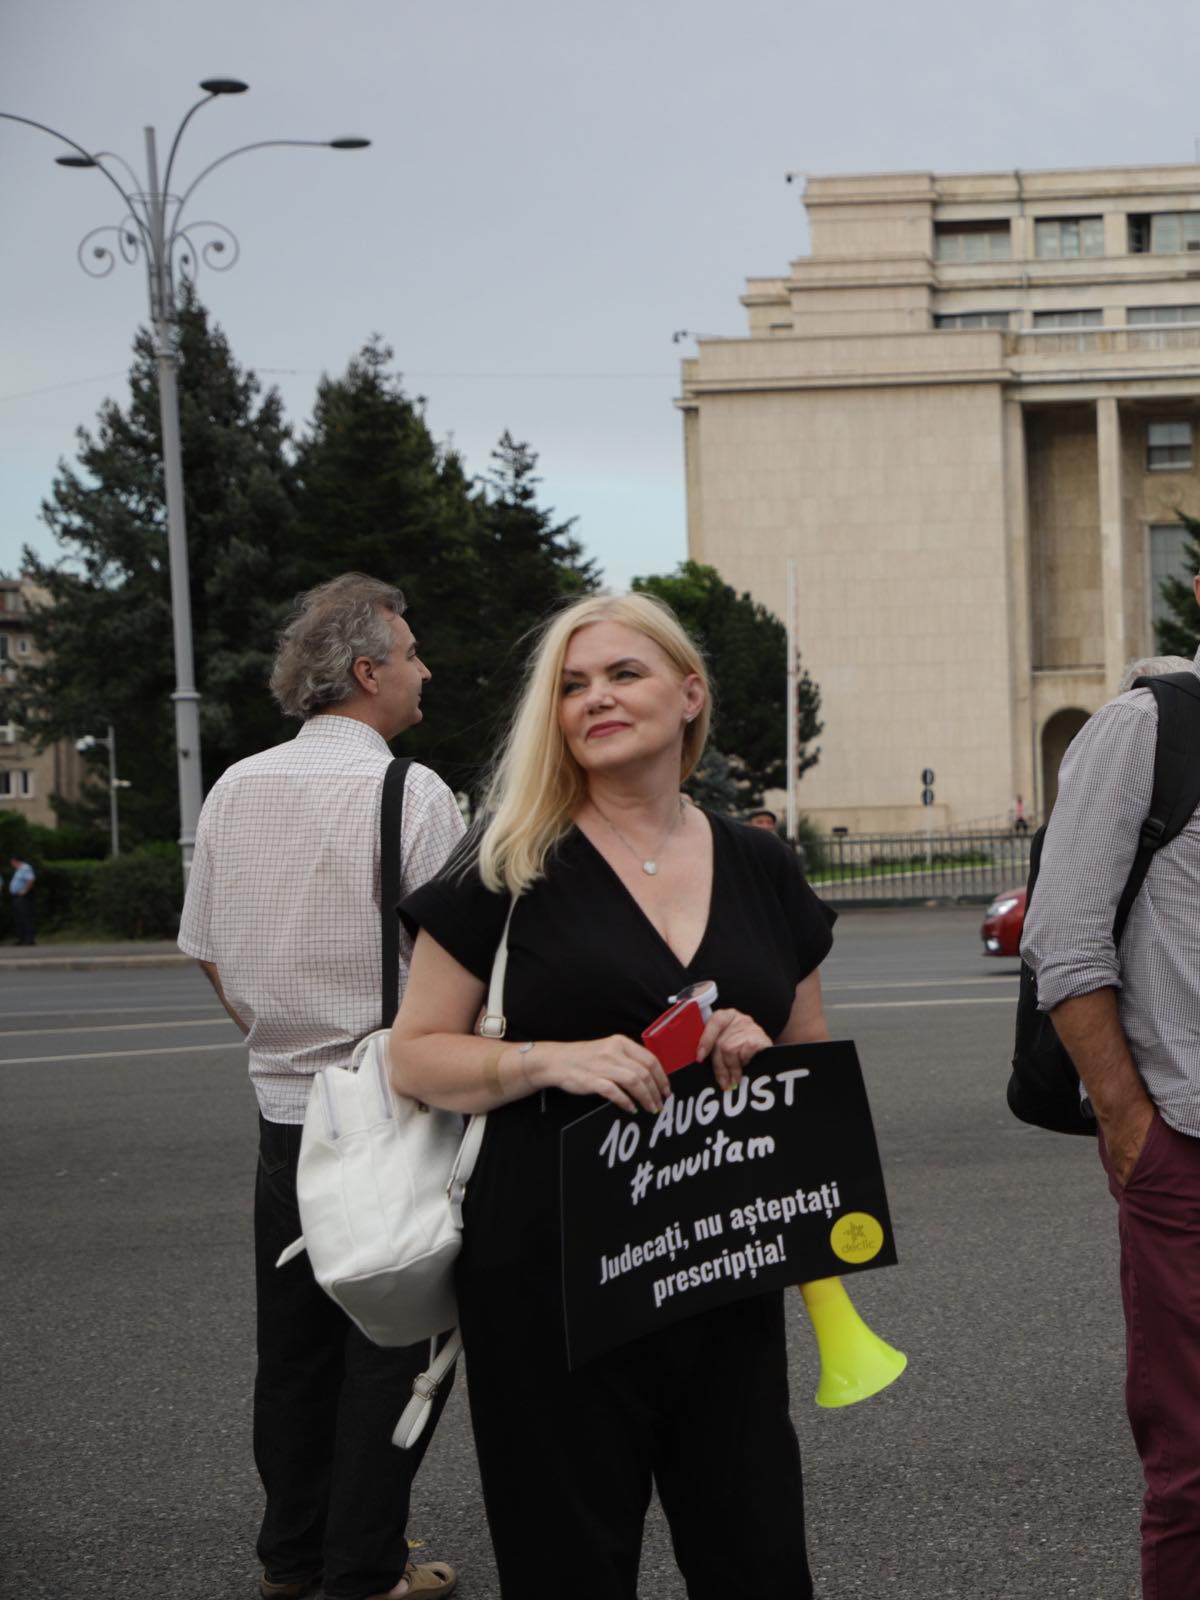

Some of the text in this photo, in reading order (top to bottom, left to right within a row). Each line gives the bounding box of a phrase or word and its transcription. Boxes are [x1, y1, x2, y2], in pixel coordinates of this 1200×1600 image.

[599, 1068, 810, 1169] 10 AUGUST
[630, 1130, 775, 1206] #nuuitam
[600, 1181, 841, 1285] Judecați, nu așteptați
[653, 1234, 786, 1308] prescripția!
